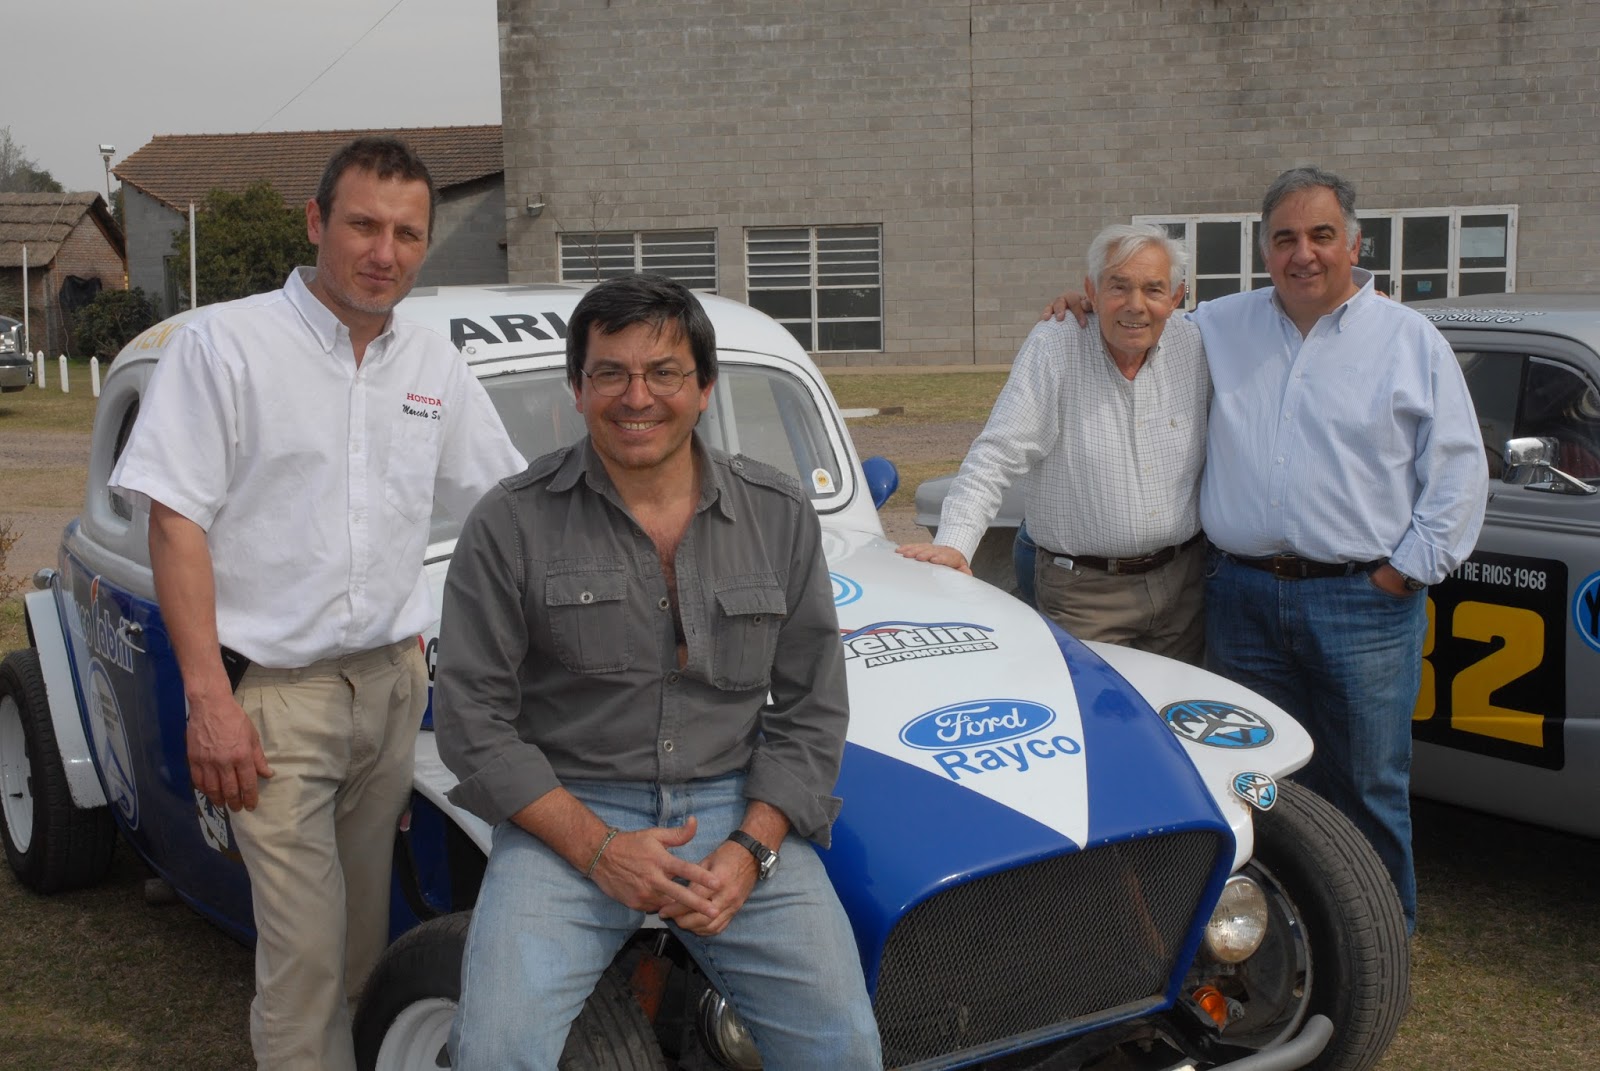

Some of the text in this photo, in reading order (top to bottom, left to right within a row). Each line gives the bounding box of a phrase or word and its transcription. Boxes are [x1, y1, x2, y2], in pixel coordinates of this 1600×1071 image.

[402, 404, 429, 419] Marcelo
[406, 392, 442, 407] HONDA
[1482, 563, 1512, 586] RIOS
[1514, 567, 1547, 591] 1968
[866, 641, 999, 669] AUTOMOTORES
[934, 705, 1028, 742] Ford
[932, 735, 1081, 781] Rayco
